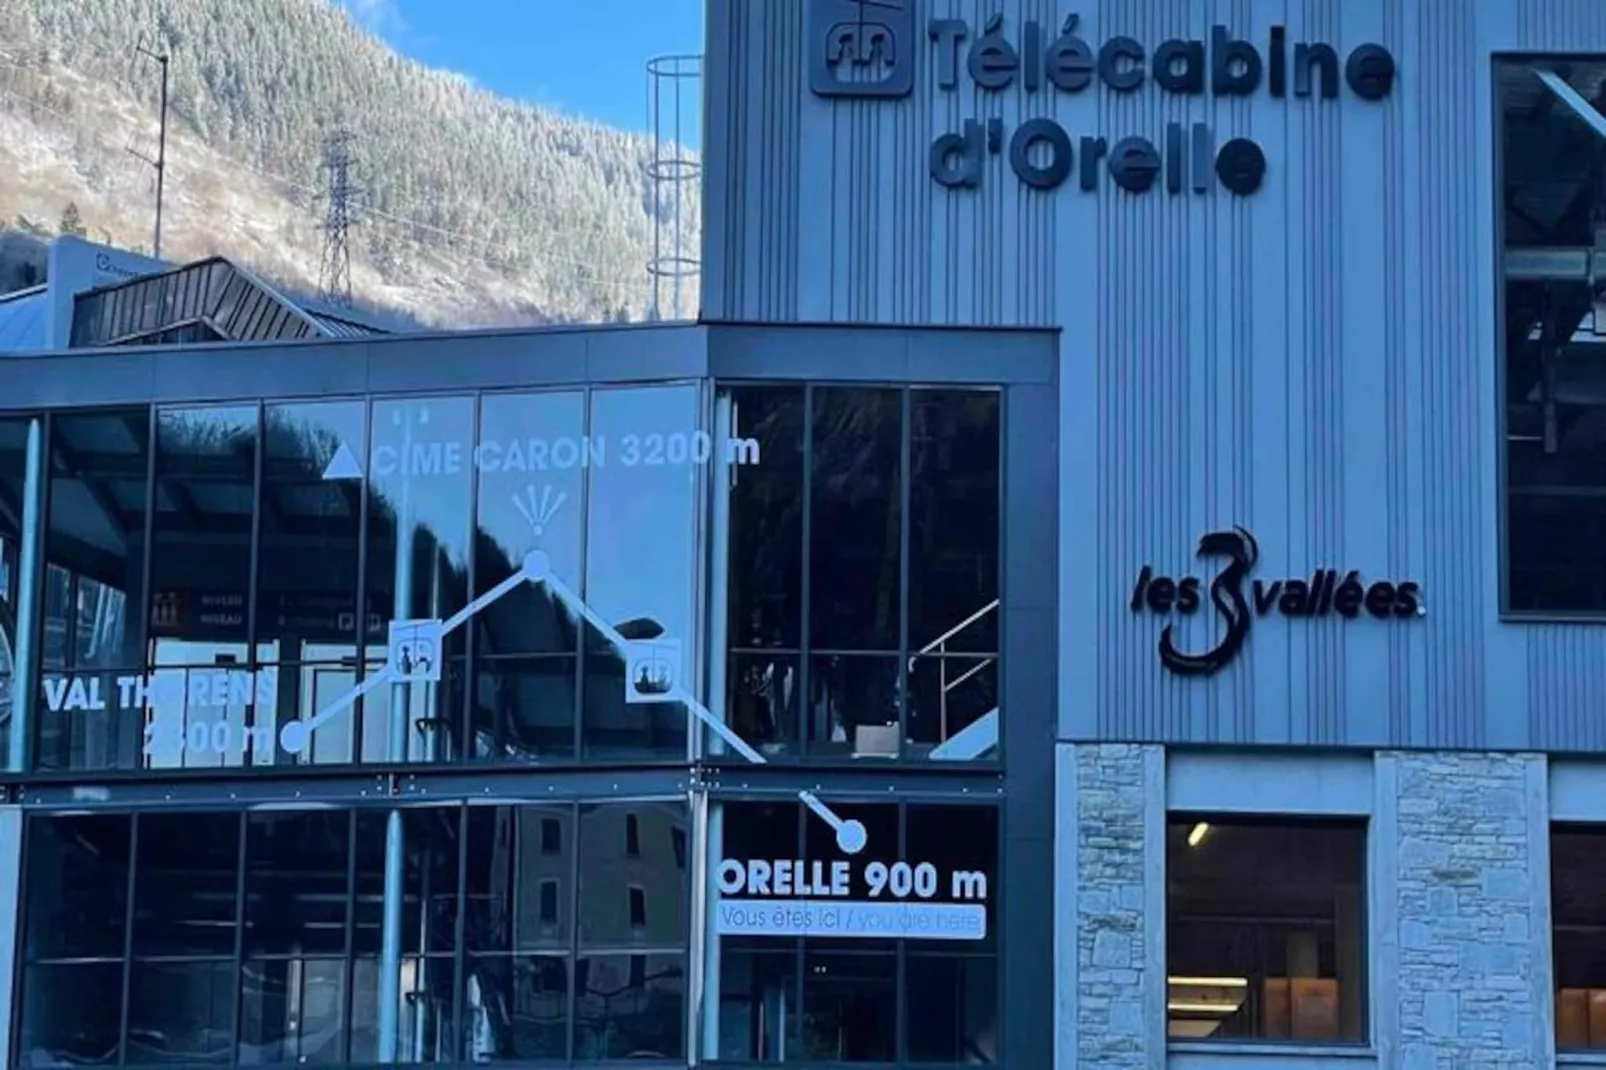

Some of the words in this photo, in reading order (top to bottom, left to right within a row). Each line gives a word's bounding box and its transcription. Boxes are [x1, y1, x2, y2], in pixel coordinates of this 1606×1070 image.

[928, 13, 1396, 99] Télécabine
[929, 118, 1267, 195] d'Orelle
[374, 442, 461, 476] CIME
[474, 436, 605, 473] CARON
[621, 430, 711, 466] 3200
[726, 437, 760, 465] m
[1131, 563, 1199, 614] les
[1159, 525, 1258, 676] 3
[1253, 569, 1420, 618] vallées
[43, 676, 106, 711] VAL
[116, 671, 273, 709] THRENS
[143, 721, 231, 754] 200
[716, 858, 851, 896] ORELLE
[864, 862, 938, 898] 900
[952, 869, 987, 899] m
[721, 907, 766, 927] Vous
[773, 906, 812, 928] êtes
